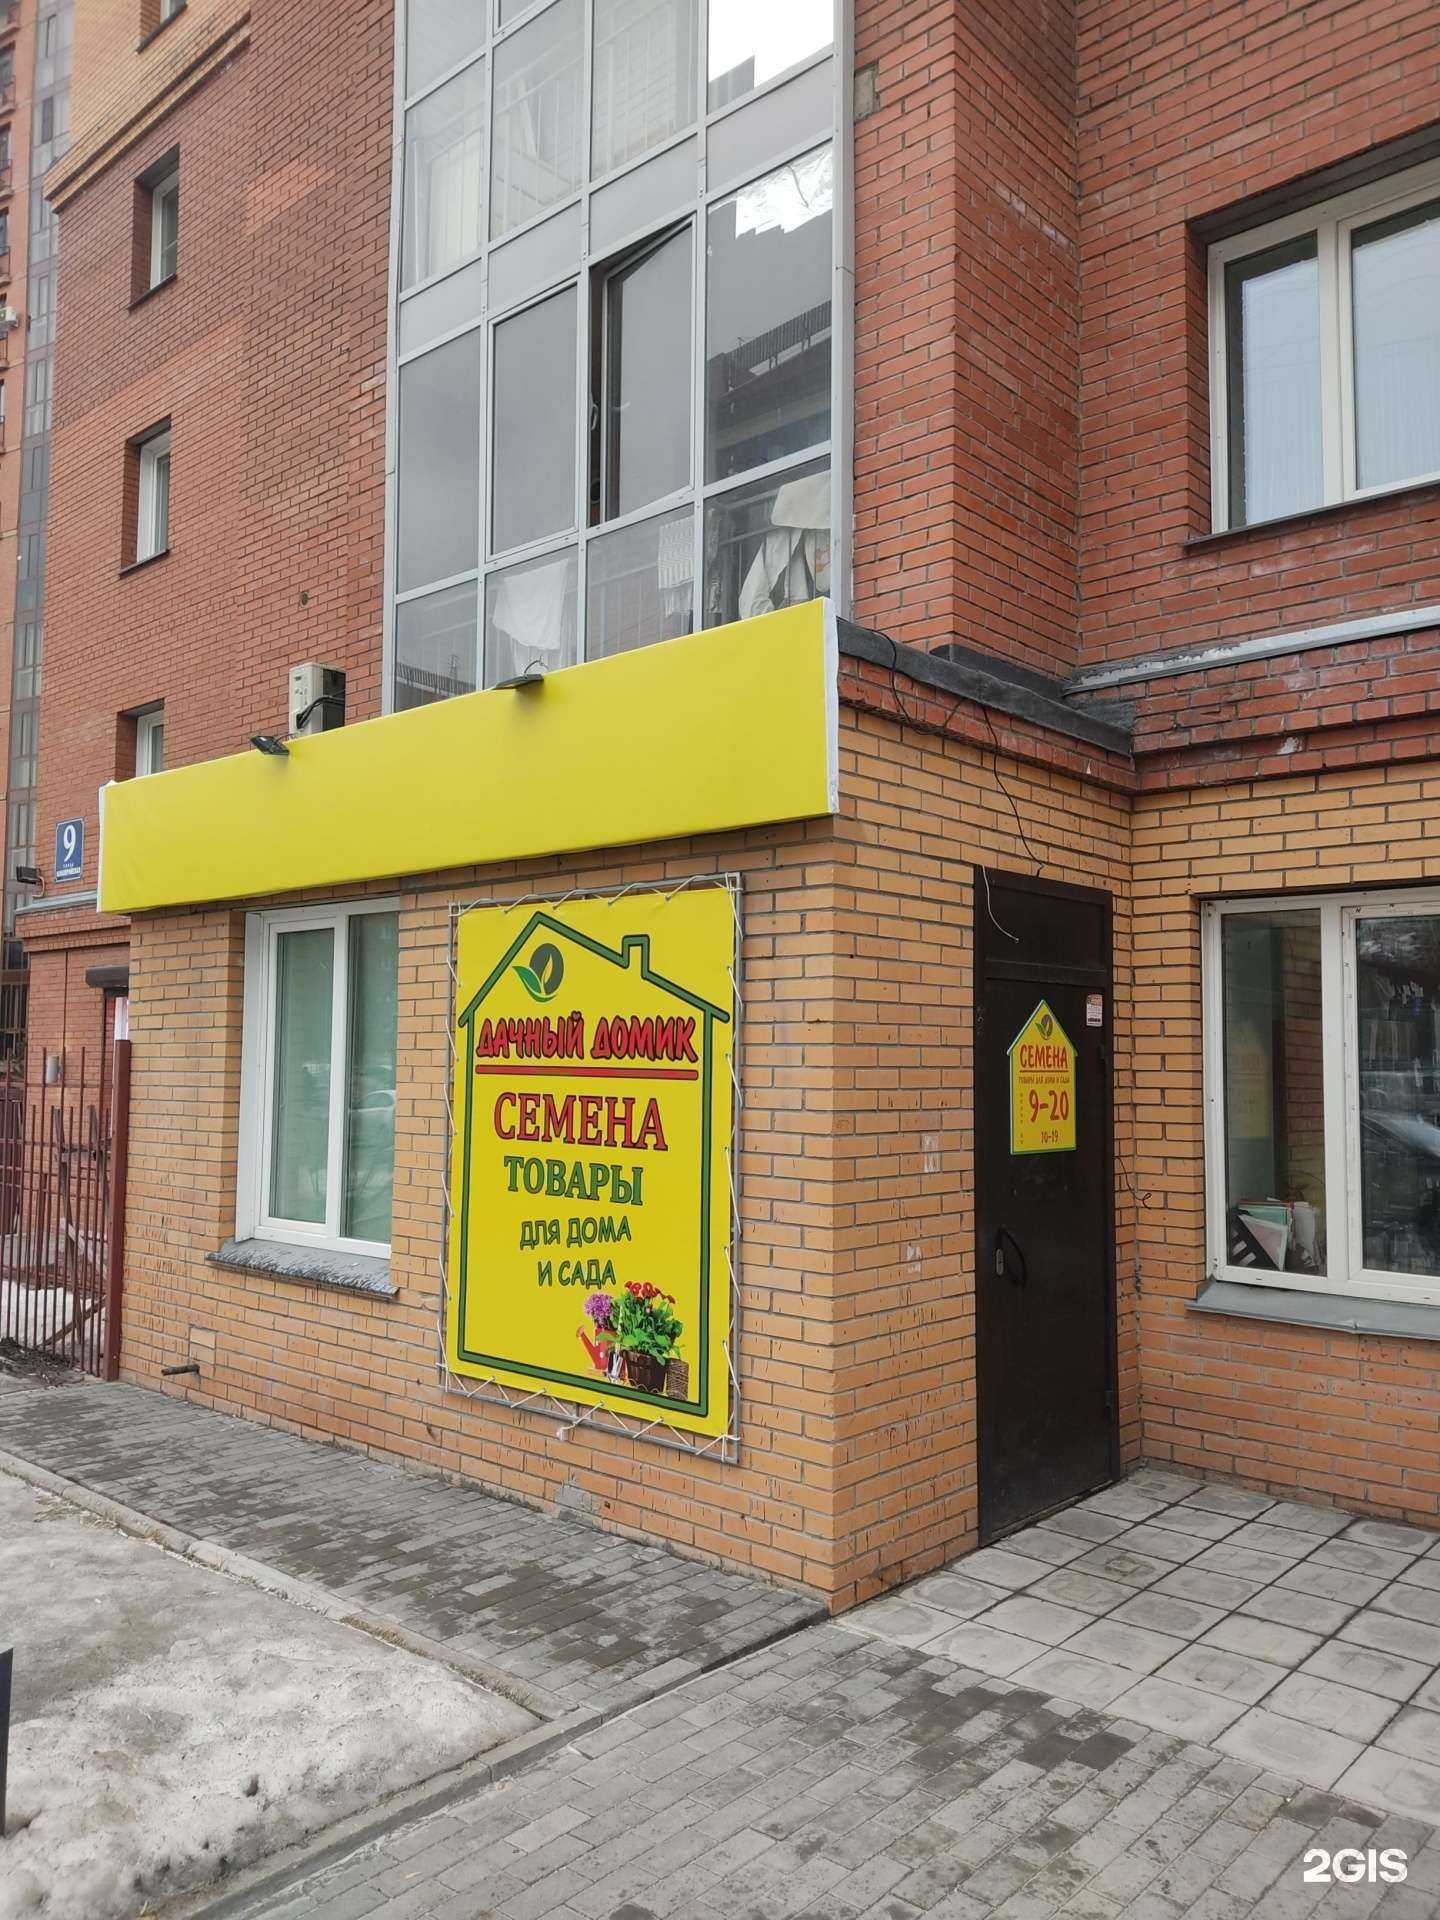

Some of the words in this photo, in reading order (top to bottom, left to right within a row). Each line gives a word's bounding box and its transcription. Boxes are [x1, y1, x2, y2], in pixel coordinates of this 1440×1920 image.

[63, 824, 76, 862] 9
[476, 1011, 584, 1059] ДАЧНЫЙ
[590, 1015, 698, 1063] ДОМИК
[1020, 1044, 1068, 1069] СЕМЕНА
[493, 1091, 669, 1151] СЕМЕНА
[1029, 1089, 1069, 1122] 9-20
[503, 1155, 644, 1206] ТОВАРЫ
[519, 1220, 561, 1251] ДЛЯ
[566, 1215, 632, 1247] ДОМА
[537, 1259, 553, 1287] И
[557, 1258, 616, 1290] САДА
